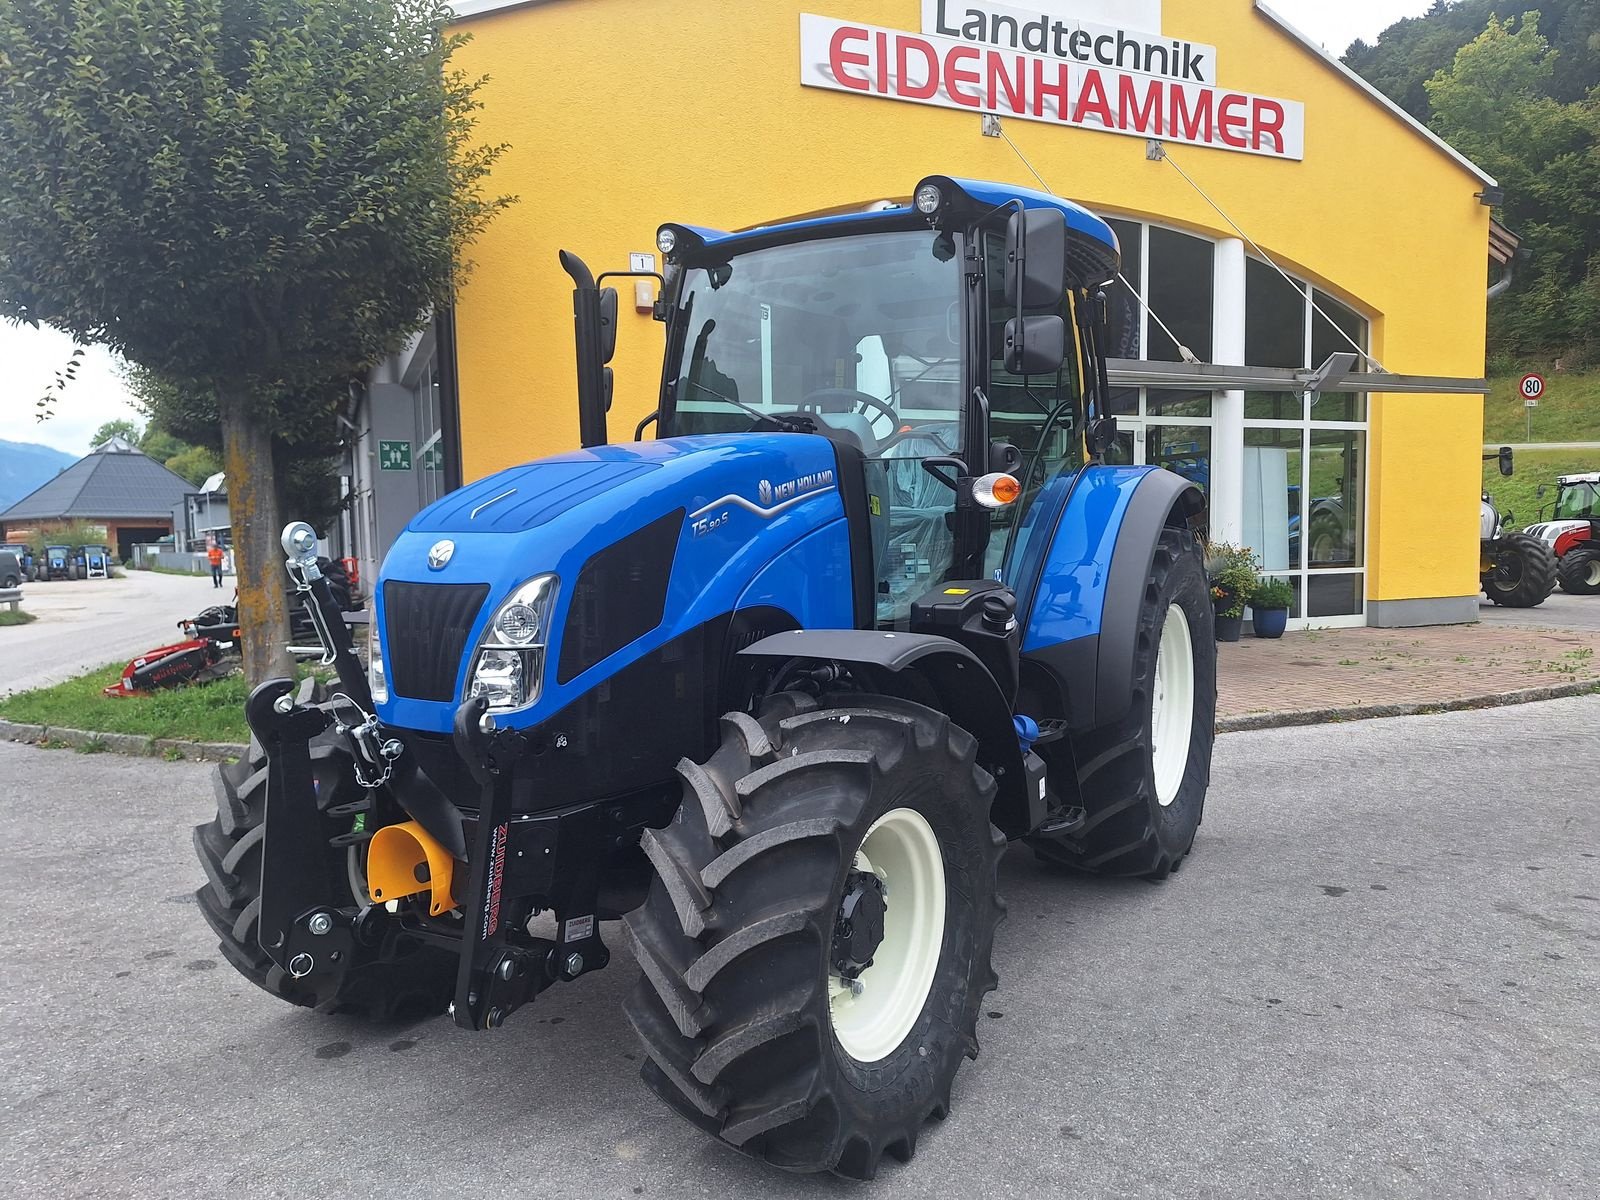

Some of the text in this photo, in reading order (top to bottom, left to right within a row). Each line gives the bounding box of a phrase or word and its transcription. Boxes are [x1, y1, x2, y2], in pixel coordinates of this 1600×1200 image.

[936, 0, 1204, 81] Landtechnik
[829, 27, 1285, 153] EIDENHAMMER
[640, 258, 644, 268] 1
[1525, 379, 1540, 394] 80
[774, 469, 833, 501] NEW HOLLAND
[482, 827, 498, 940] www.zuidberg.com
[488, 822, 508, 935] ZUIDBERG
